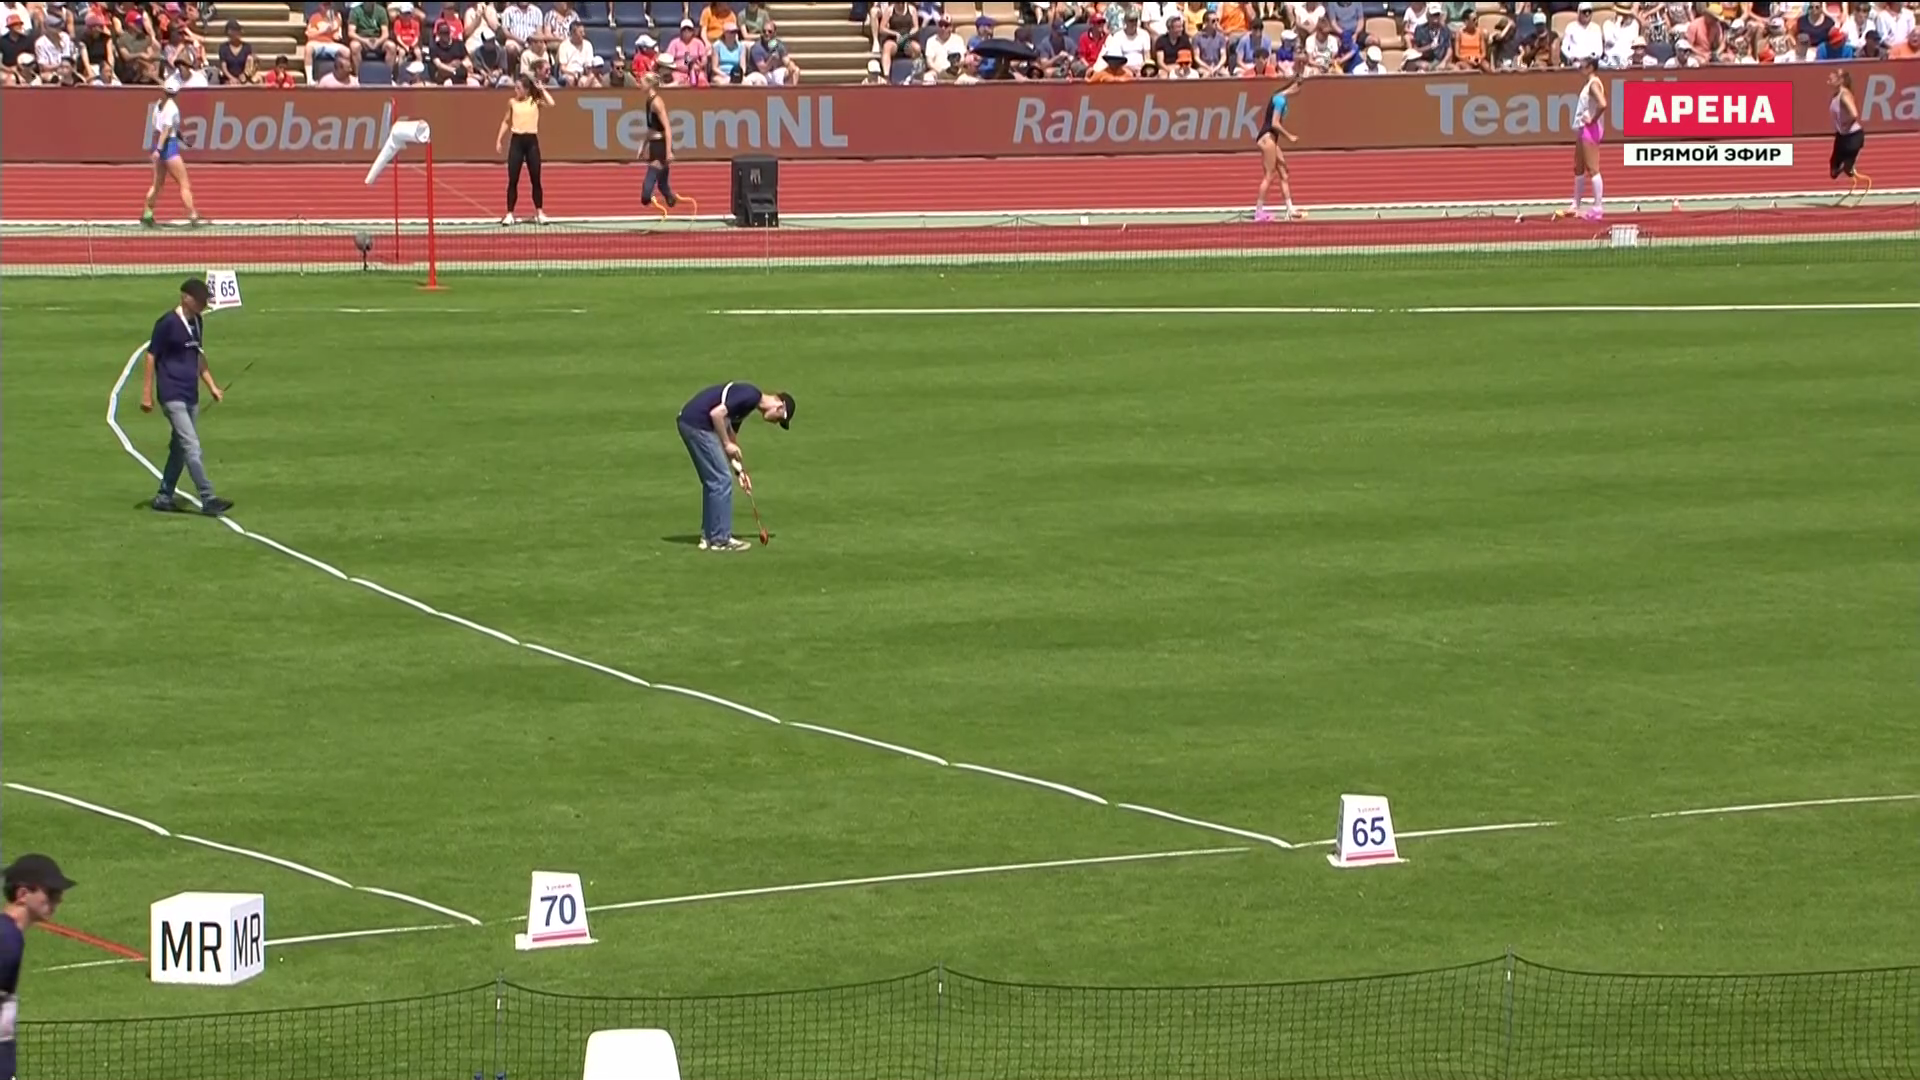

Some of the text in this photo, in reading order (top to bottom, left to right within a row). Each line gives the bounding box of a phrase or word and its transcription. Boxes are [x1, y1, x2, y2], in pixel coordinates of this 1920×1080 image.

[142, 101, 409, 151] aboban
[577, 95, 848, 150] TeamNL
[1012, 92, 1262, 144] Rabobank
[220, 280, 236, 297] 65
[1352, 816, 1386, 847] 65
[540, 893, 577, 927] 70
[162, 920, 222, 973] MR
[234, 911, 261, 971] MR
